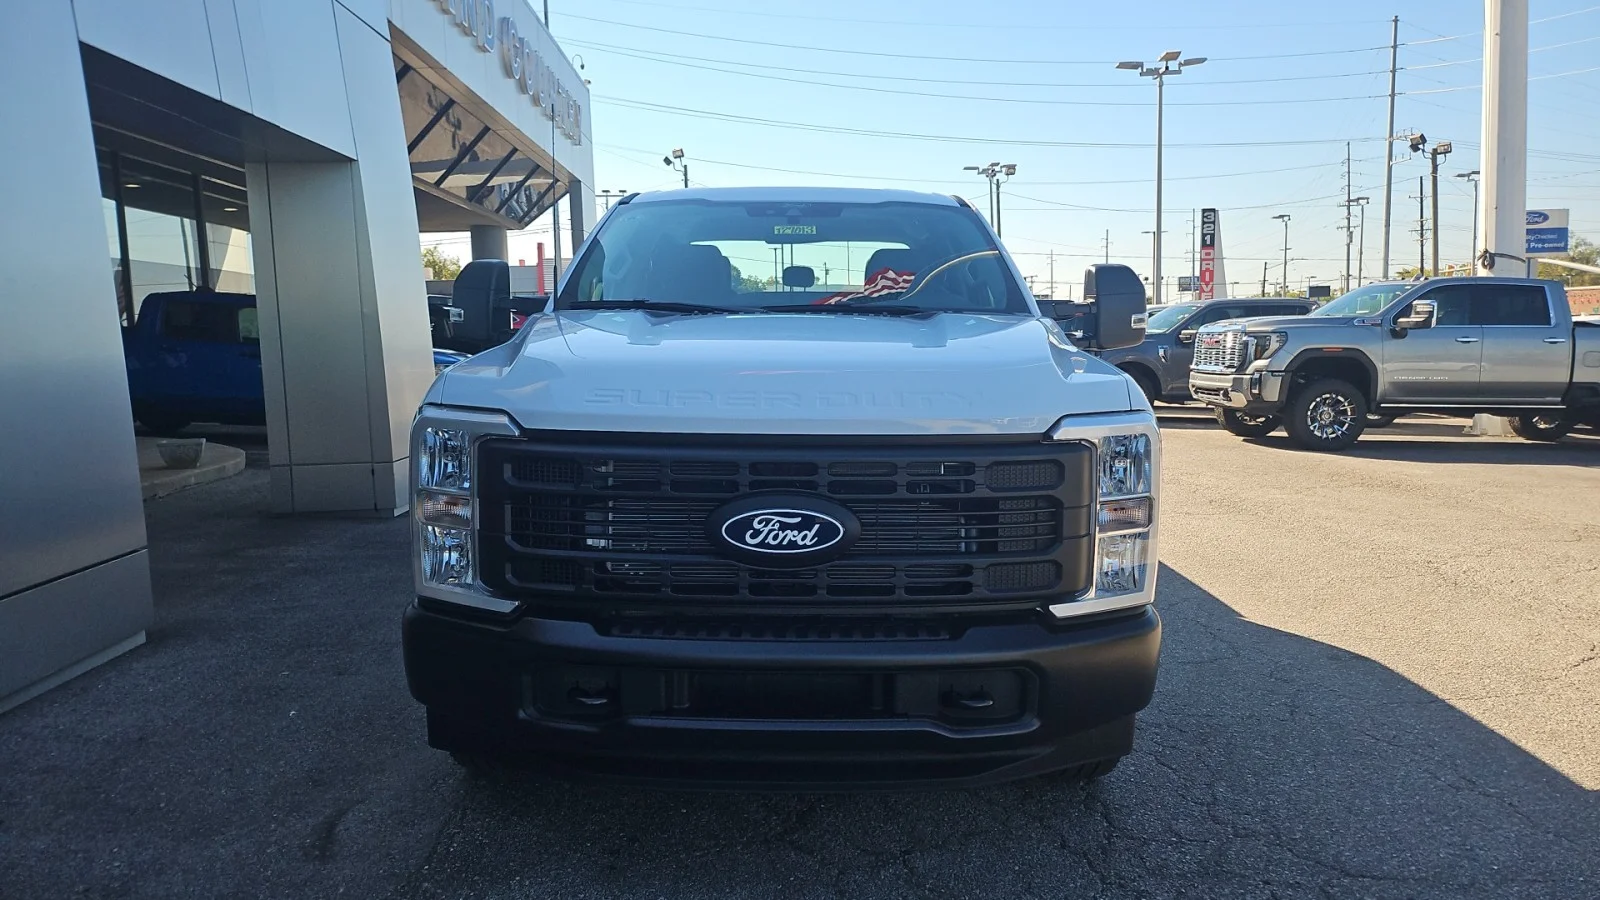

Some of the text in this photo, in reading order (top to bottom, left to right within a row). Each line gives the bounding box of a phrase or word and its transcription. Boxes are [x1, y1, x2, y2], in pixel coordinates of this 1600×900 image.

[1203, 211, 1215, 245] 321
[1201, 249, 1214, 300] DRIVE
[583, 387, 984, 410] SUPER DUTY
[745, 515, 820, 545] Ford
